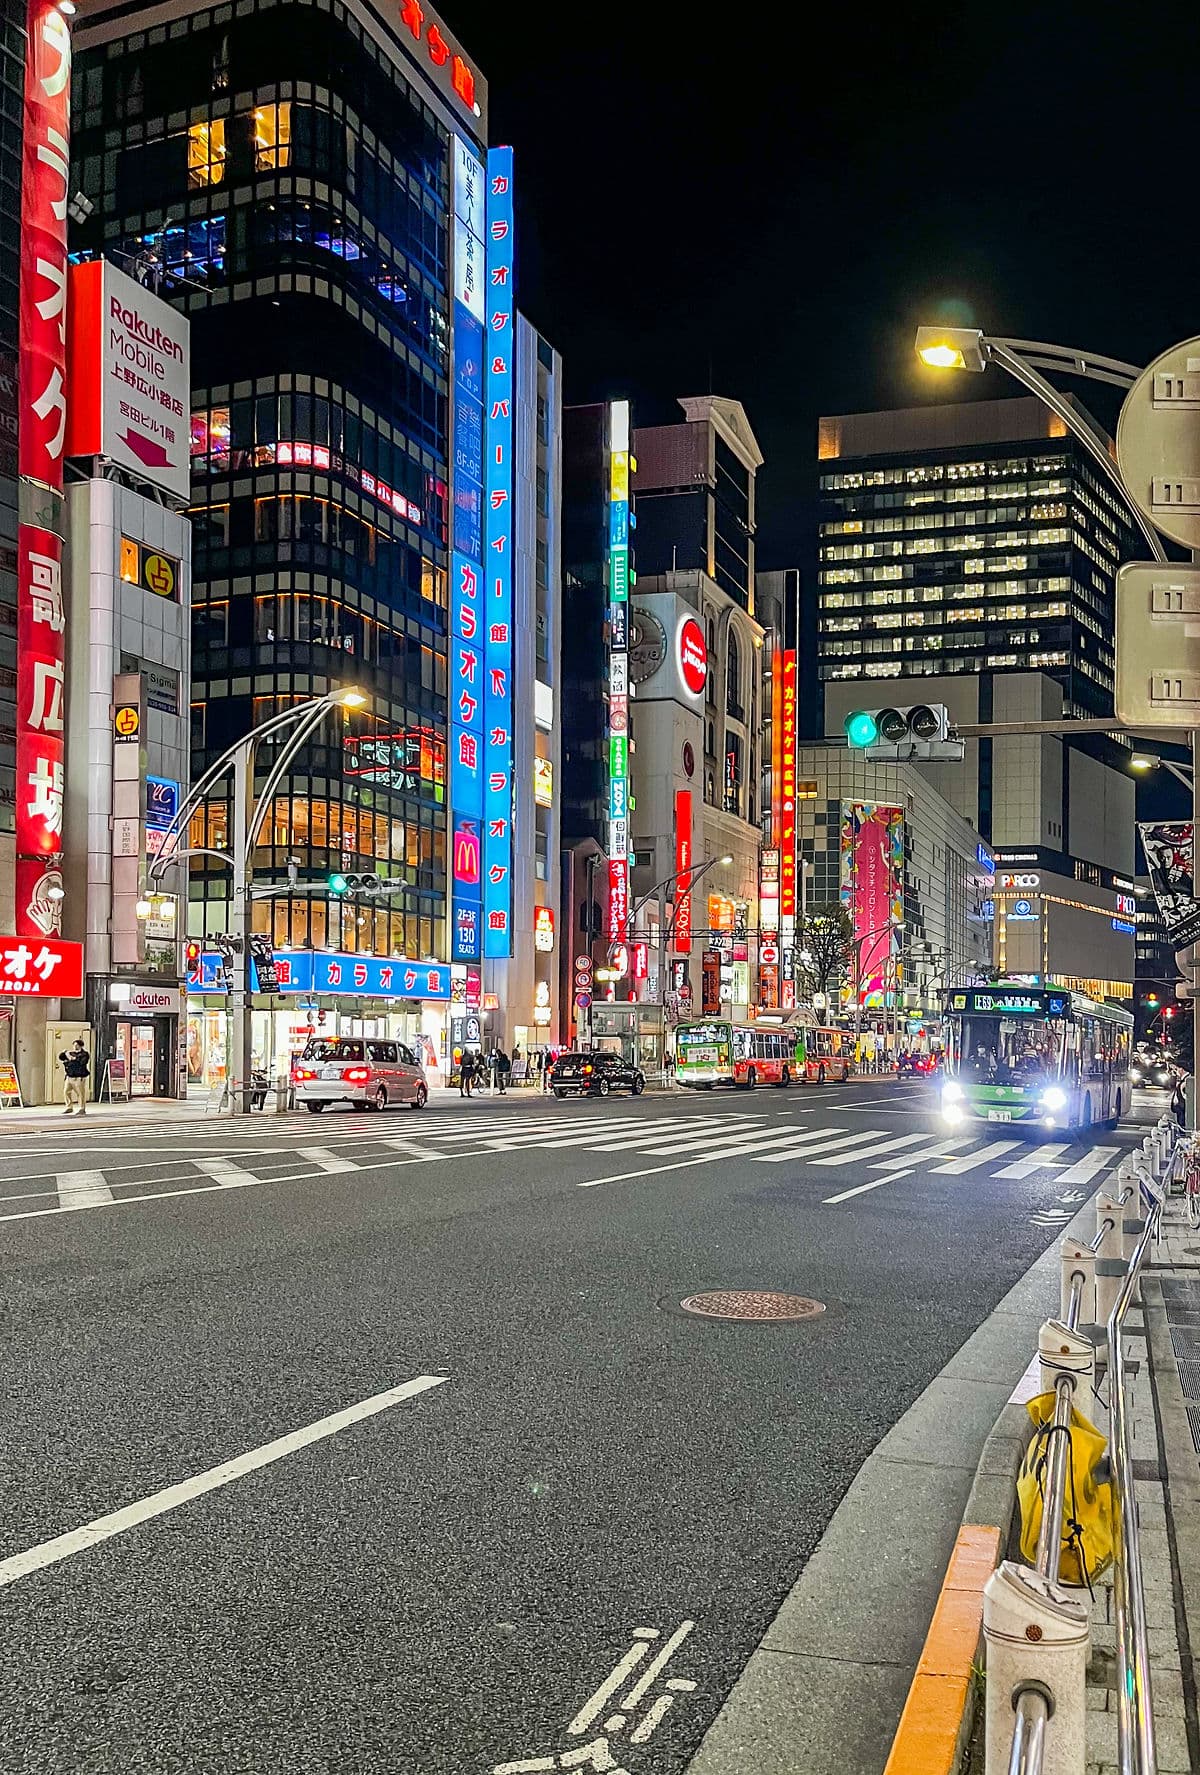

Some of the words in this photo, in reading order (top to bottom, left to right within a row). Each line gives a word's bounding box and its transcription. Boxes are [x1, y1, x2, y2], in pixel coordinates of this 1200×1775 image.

[462, 150, 478, 178] 10F
[111, 296, 183, 364] Rakuten
[111, 328, 164, 381] Mobile
[111, 361, 183, 417] 上野広小路店
[120, 400, 175, 444] 宮田ビル1階
[459, 564, 478, 771] カラオケ館
[489, 728, 508, 930] カラオケ館
[1001, 874, 1040, 887] PARCO
[458, 944, 475, 955] SEATS
[459, 927, 475, 943] 130
[0, 944, 62, 980] オケ
[328, 962, 440, 990] カラオケ館
